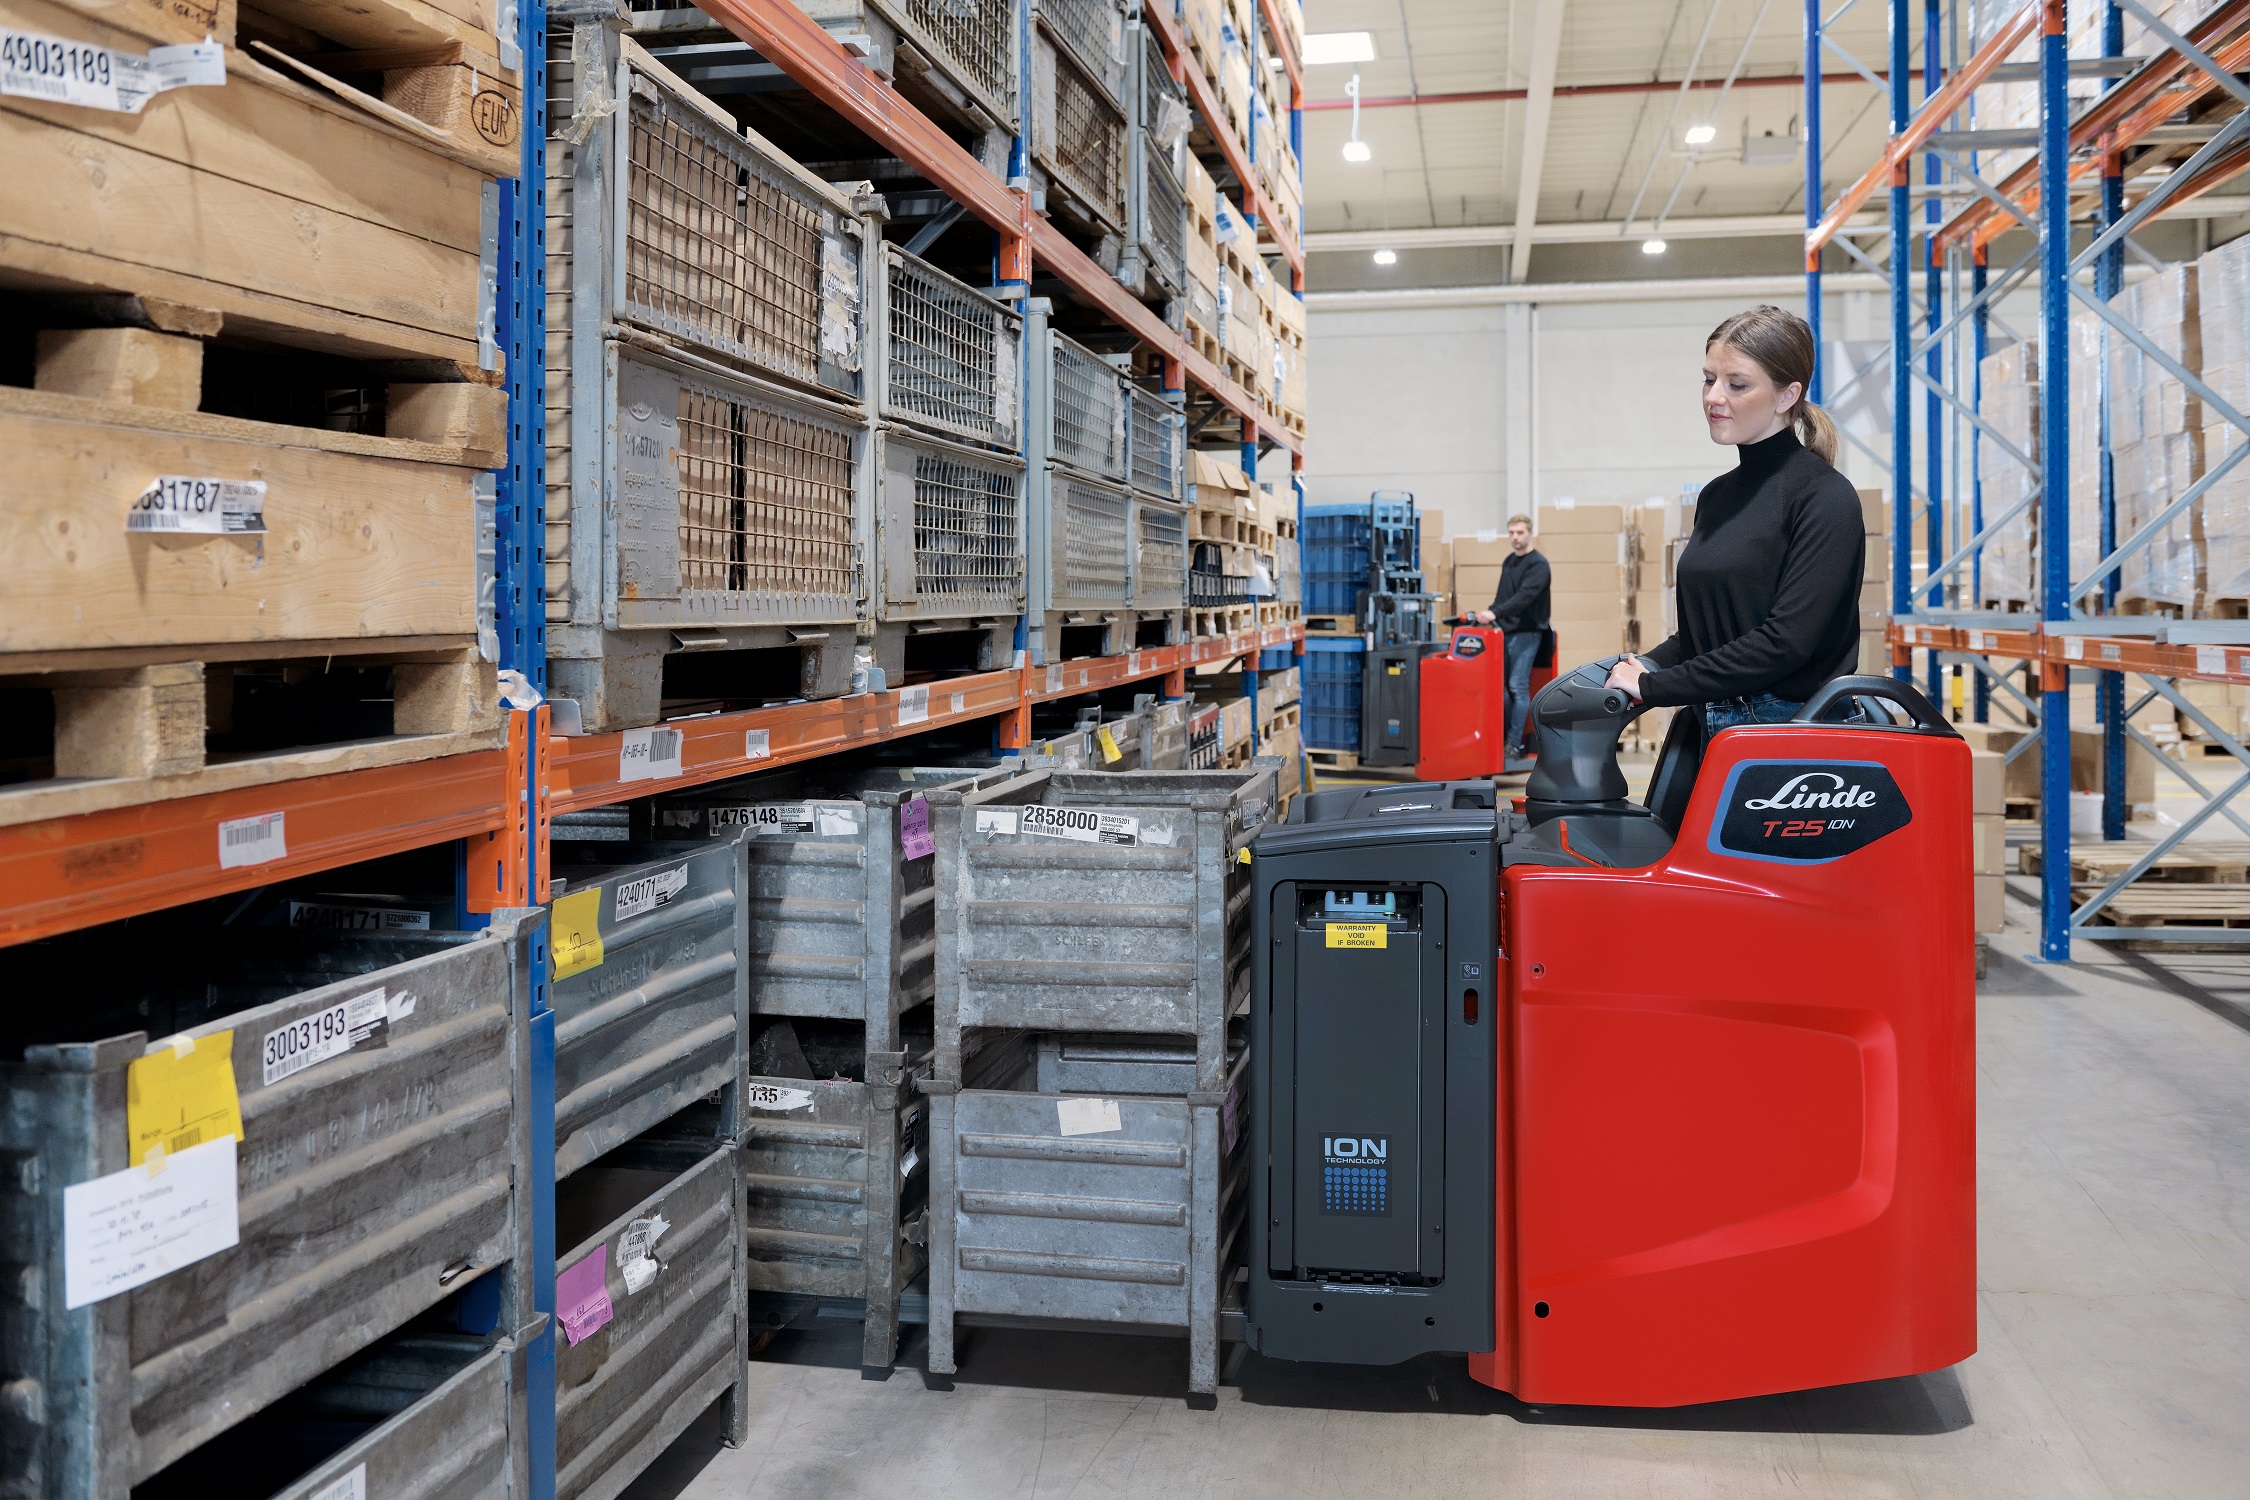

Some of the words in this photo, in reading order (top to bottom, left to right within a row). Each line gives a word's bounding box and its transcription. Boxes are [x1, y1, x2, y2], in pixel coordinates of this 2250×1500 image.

[3, 36, 110, 86] 4903189
[481, 98, 508, 139] EUR
[1744, 772, 1877, 810] Linde
[711, 807, 778, 826] 1476148
[1023, 805, 1098, 831] 2858000
[1827, 819, 1855, 830] ION
[618, 877, 656, 908] 4240171
[266, 1007, 346, 1066] 3003193
[1324, 1137, 1387, 1158] ION
[1324, 1157, 1387, 1165] TECHNOLOGY
